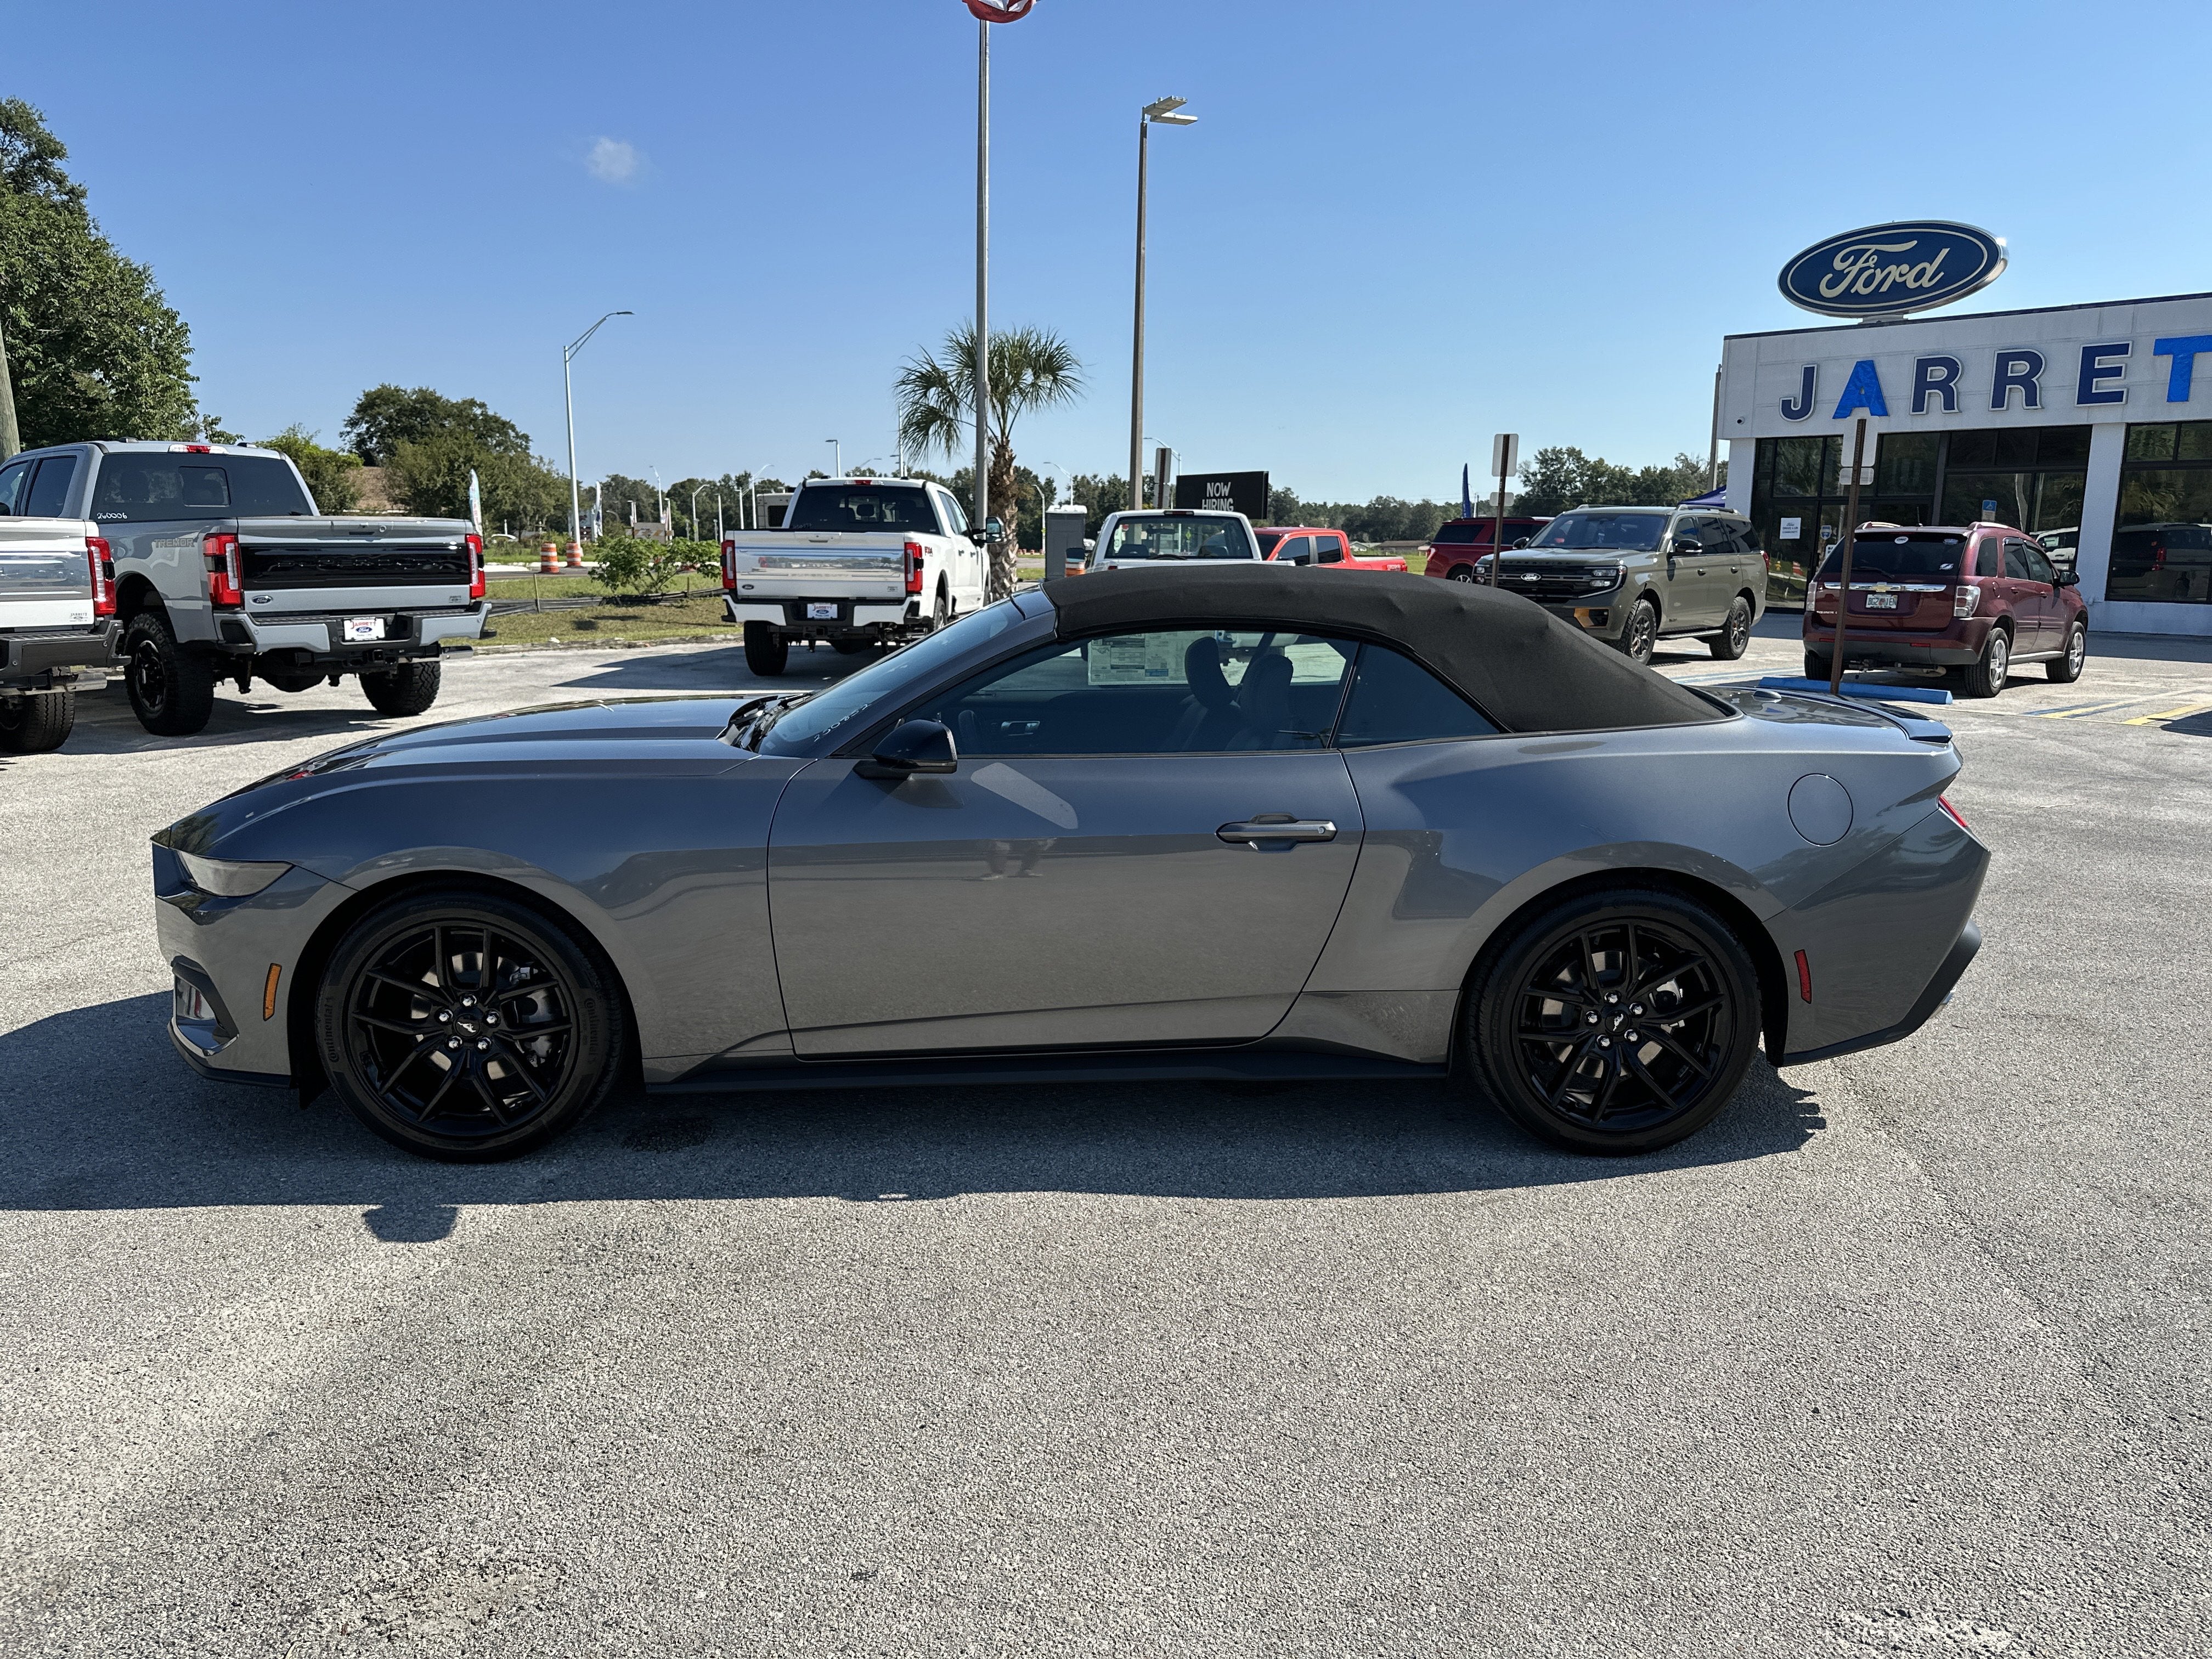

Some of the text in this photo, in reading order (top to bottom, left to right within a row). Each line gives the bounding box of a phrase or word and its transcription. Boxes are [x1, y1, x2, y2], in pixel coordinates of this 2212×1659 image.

[1819, 240, 1950, 298] Ford
[1779, 334, 2212, 422] JARRET
[1207, 482, 1231, 497] NOW
[1201, 498, 1233, 511] HIRING
[154, 538, 195, 548] TREMOR
[351, 621, 376, 629] JARRETT
[324, 1004, 340, 1063] Continental
